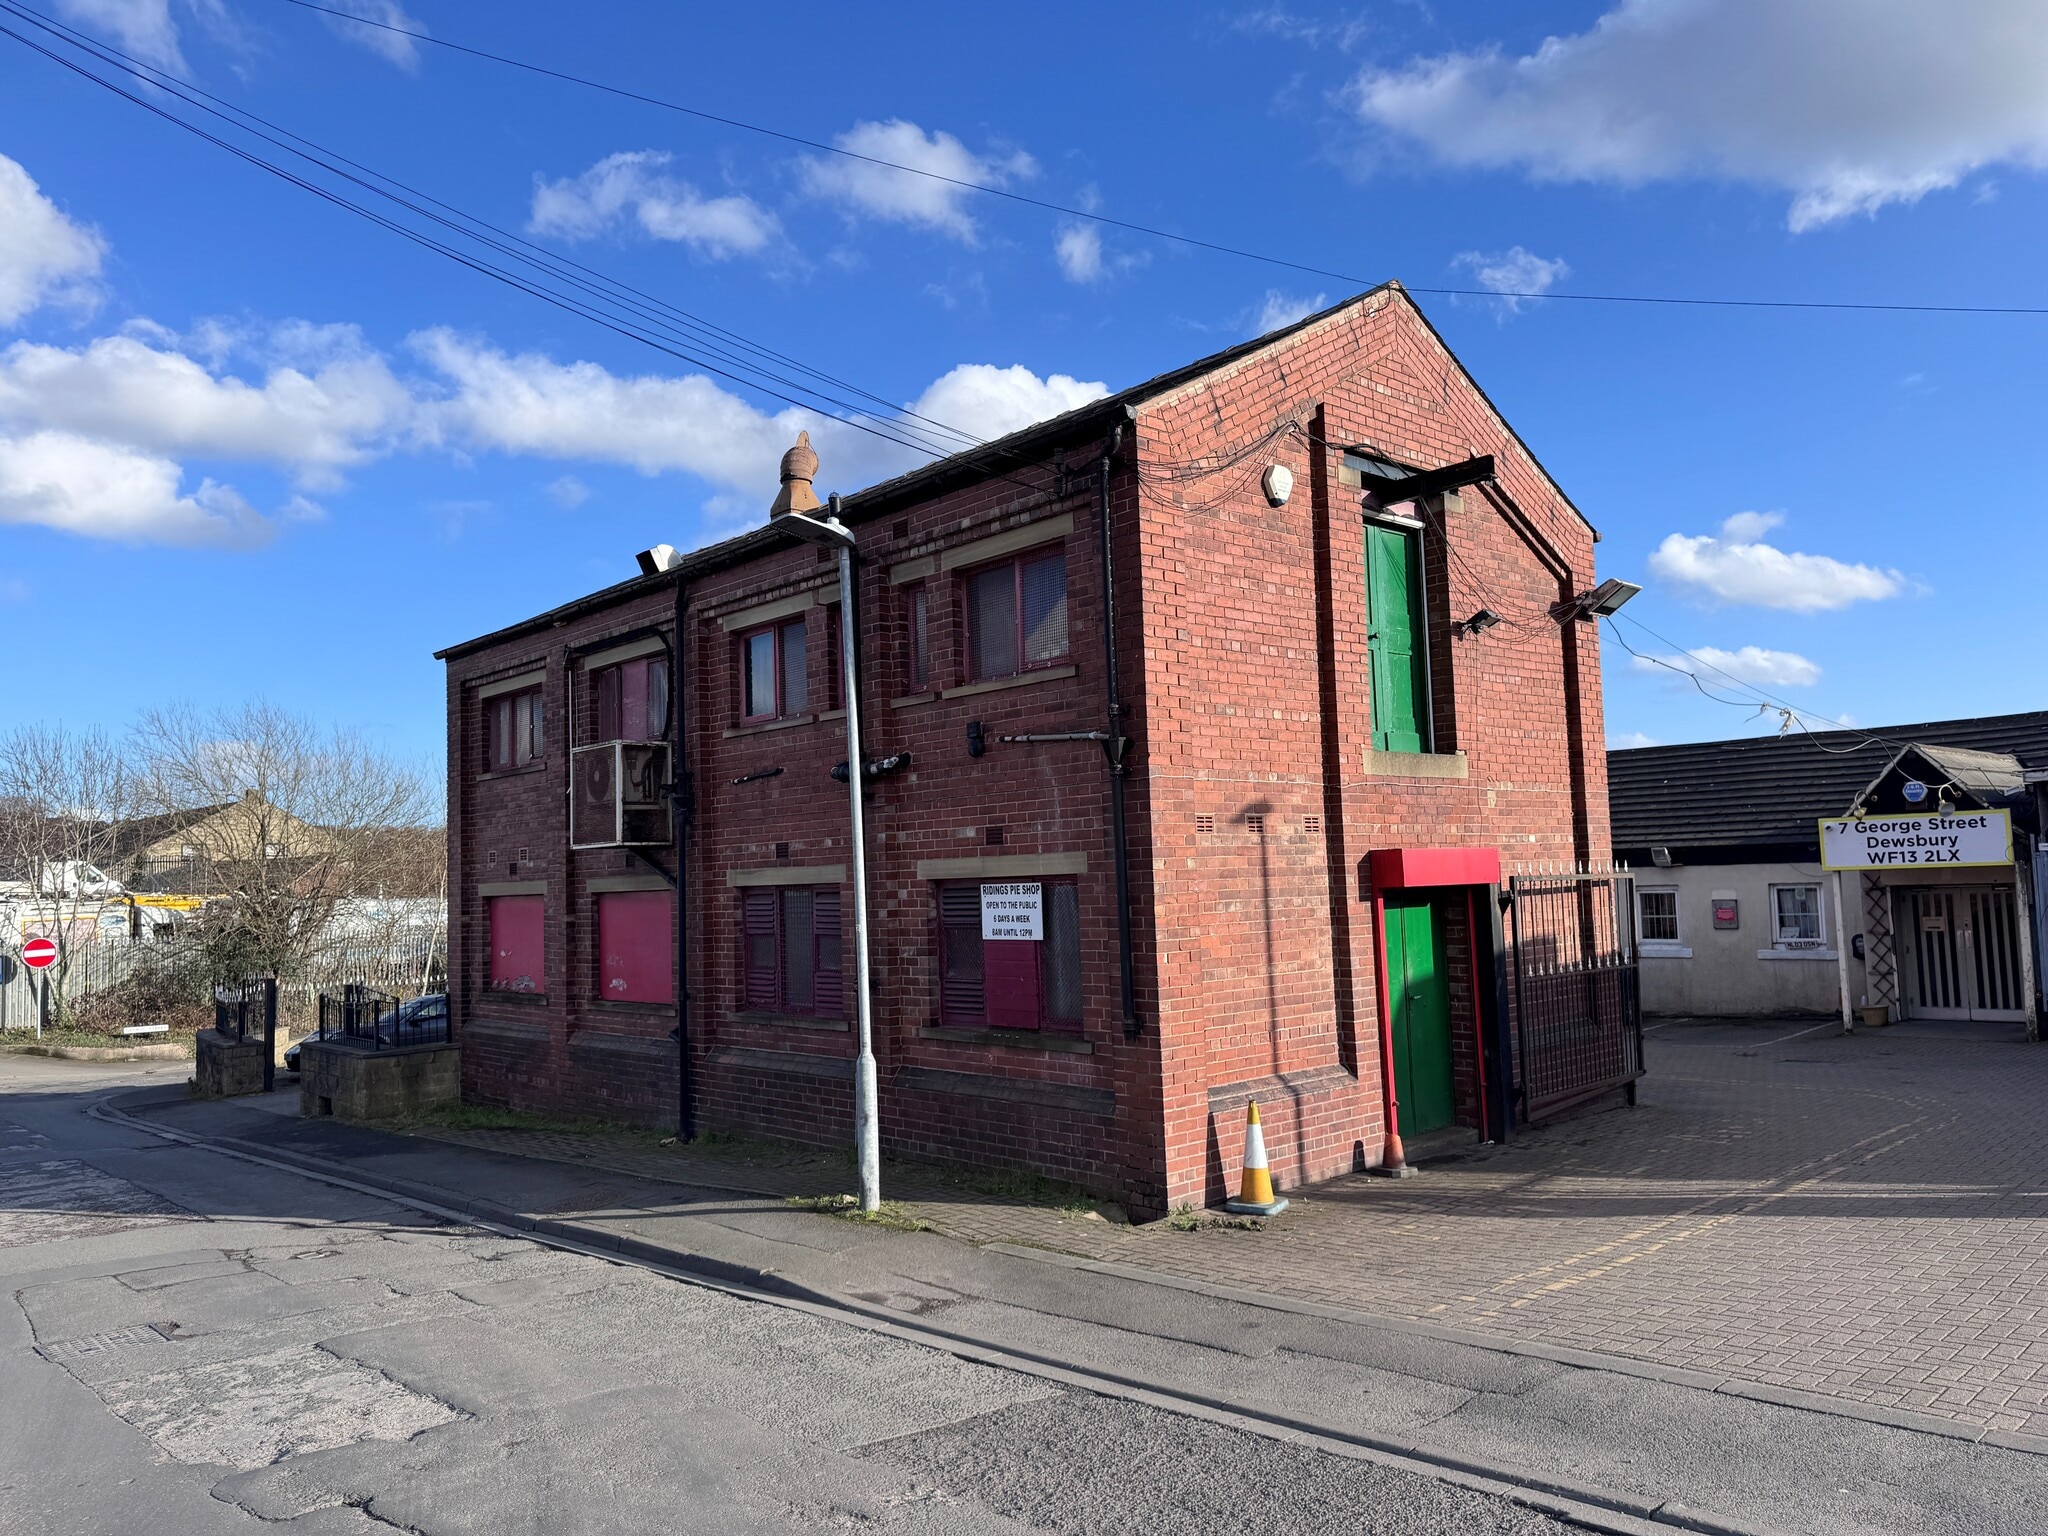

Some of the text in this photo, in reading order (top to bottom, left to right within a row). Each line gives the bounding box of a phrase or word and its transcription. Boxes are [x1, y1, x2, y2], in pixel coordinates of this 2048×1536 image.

[1838, 816, 1987, 834] 7 George Street
[1866, 834, 1958, 848] Dewsbury
[1867, 849, 1961, 864] WF13 2LX
[983, 885, 1040, 895] RIDINGS PIE SHOP
[1003, 928, 1018, 936] UNTIL
